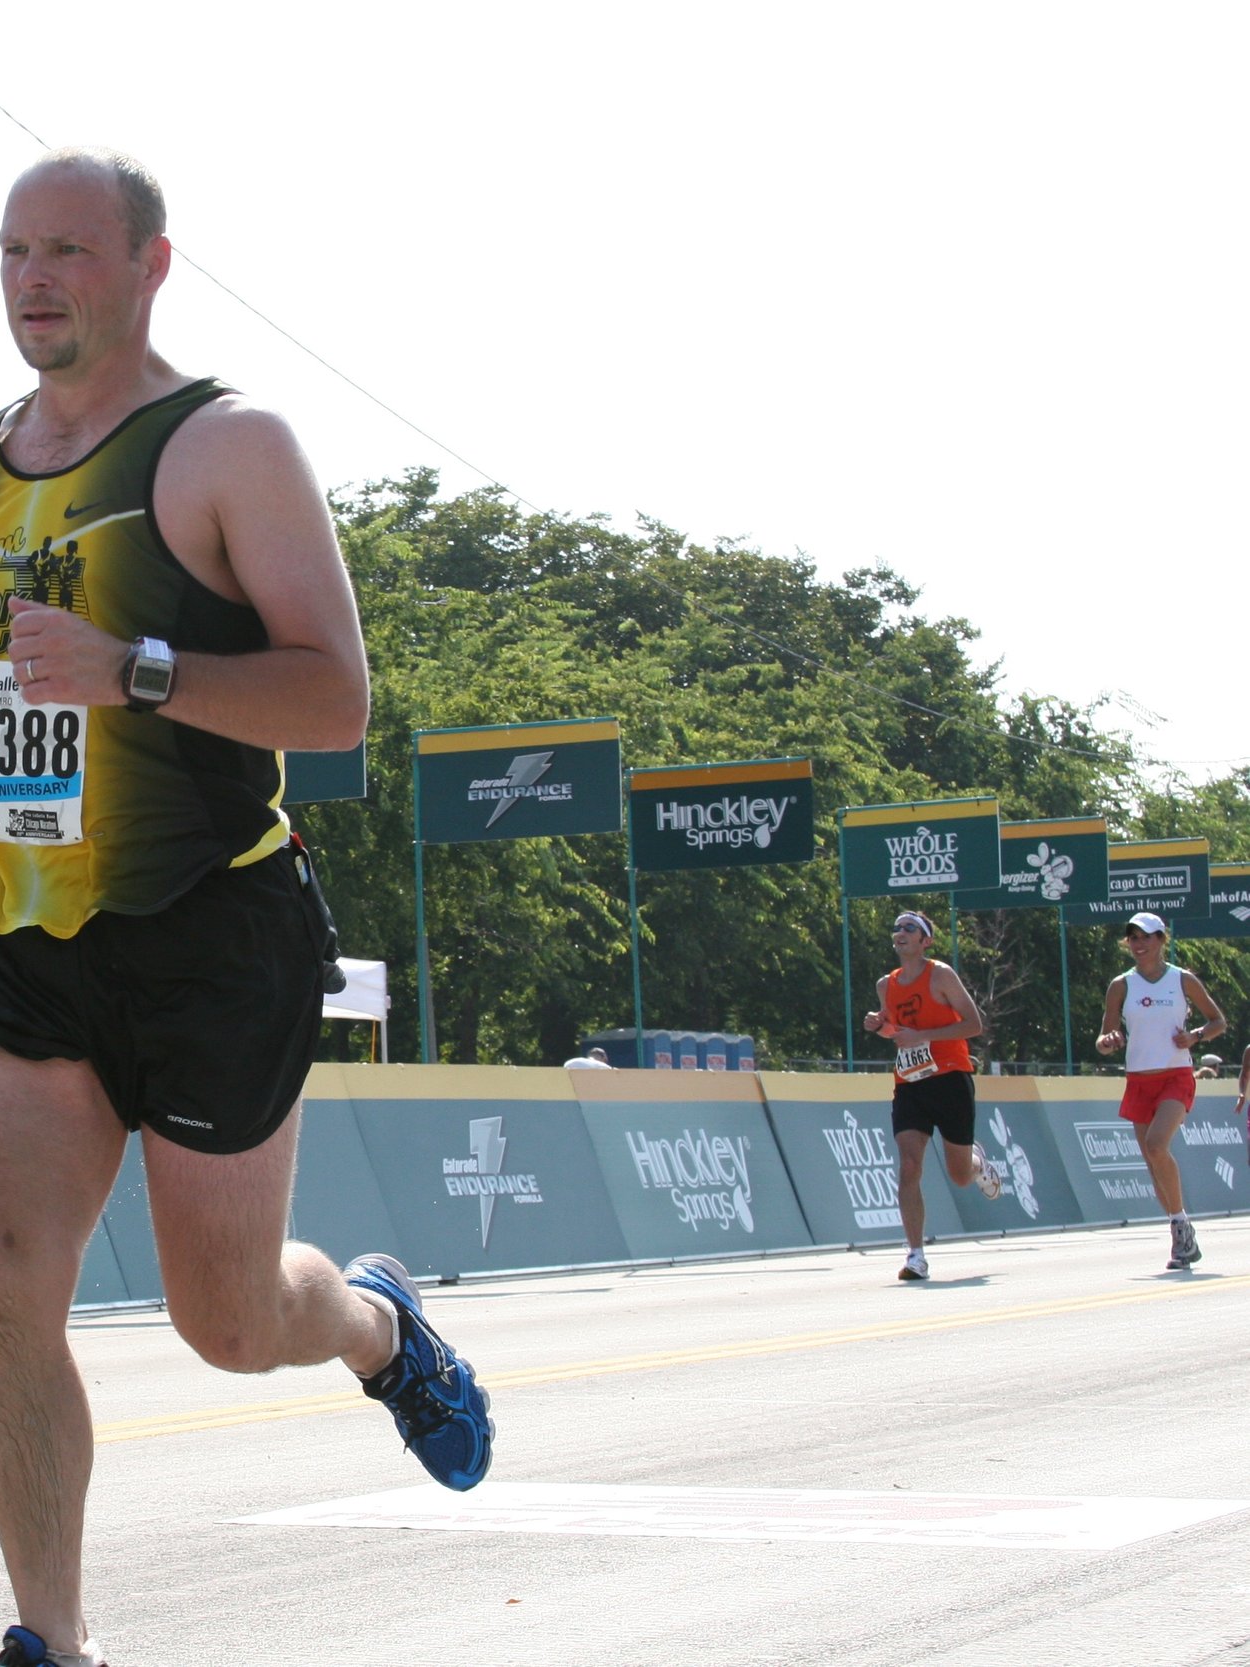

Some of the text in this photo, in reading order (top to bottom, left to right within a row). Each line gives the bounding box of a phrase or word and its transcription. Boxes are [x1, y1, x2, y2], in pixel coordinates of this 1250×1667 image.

[468, 783, 572, 801] ENDURANCE
[539, 794, 573, 802] FORMULA
[656, 796, 788, 832] Hinckley
[686, 827, 753, 850] Springs
[884, 831, 959, 857] WHOLE
[889, 853, 956, 877] FOODS
[1001, 871, 1040, 886] ergizer
[1109, 873, 1185, 891] cago Tribune
[1089, 896, 1186, 912] What's in it for you?
[1228, 890, 1240, 903] of
[904, 1047, 931, 1068] 1663
[167, 1114, 214, 1129] BROOKS
[1179, 1121, 1243, 1145] Bank of America
[822, 1126, 894, 1168] WHOLE
[1085, 1132, 1119, 1160] Chicago
[443, 1158, 478, 1174] Gatorade
[625, 1128, 751, 1203] Hinckley
[444, 1174, 540, 1196] ENDURANCE
[840, 1167, 899, 1208] FOODS
[513, 1194, 543, 1204] FORMULA
[671, 1188, 736, 1232] Springs
